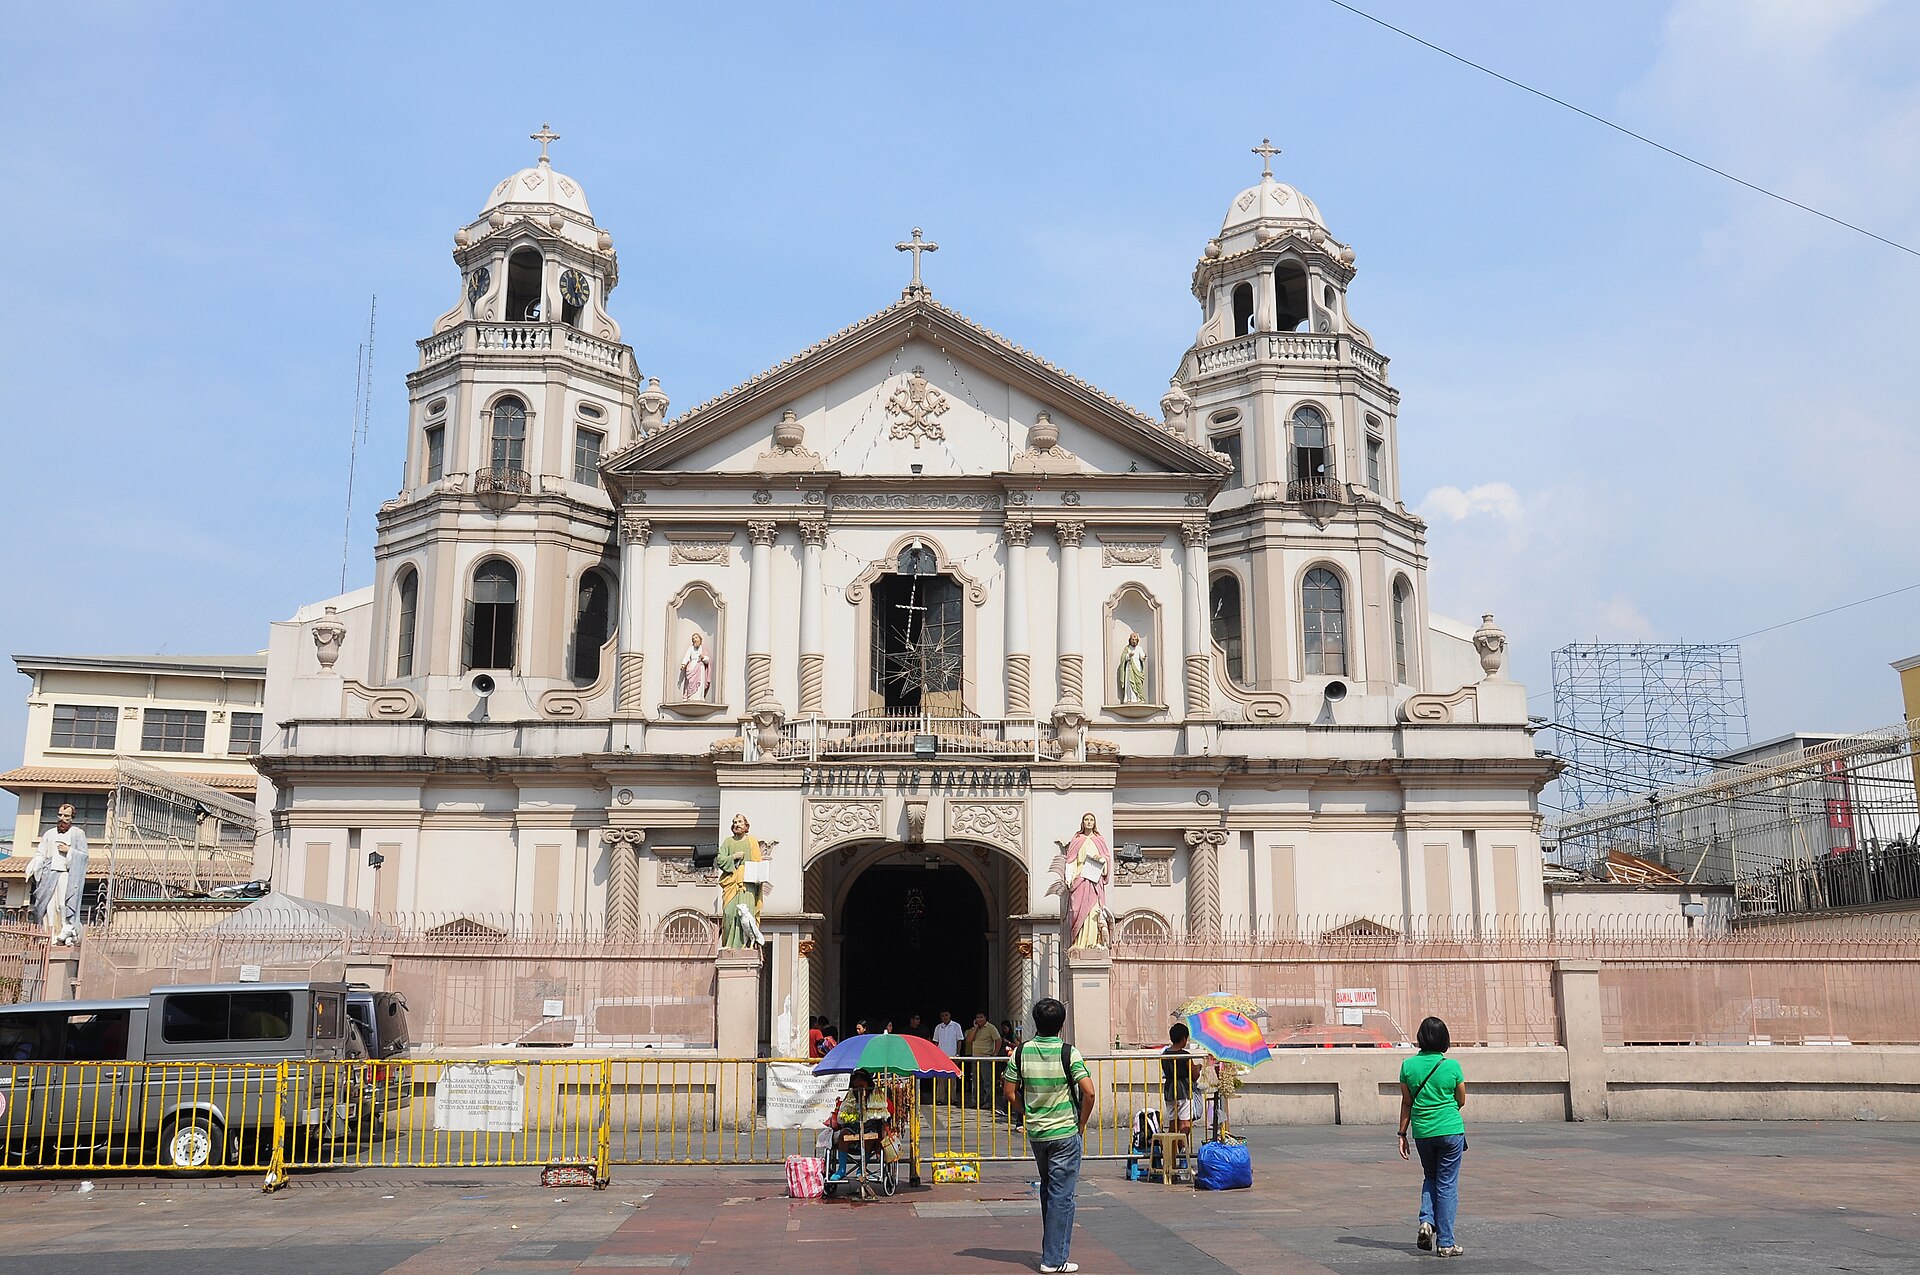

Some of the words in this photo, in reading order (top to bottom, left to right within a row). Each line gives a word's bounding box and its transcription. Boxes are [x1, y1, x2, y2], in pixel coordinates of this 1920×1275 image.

[802, 768, 885, 785] BASILIKA
[896, 768, 921, 786] NG
[931, 768, 1031, 787] NAZARENO
